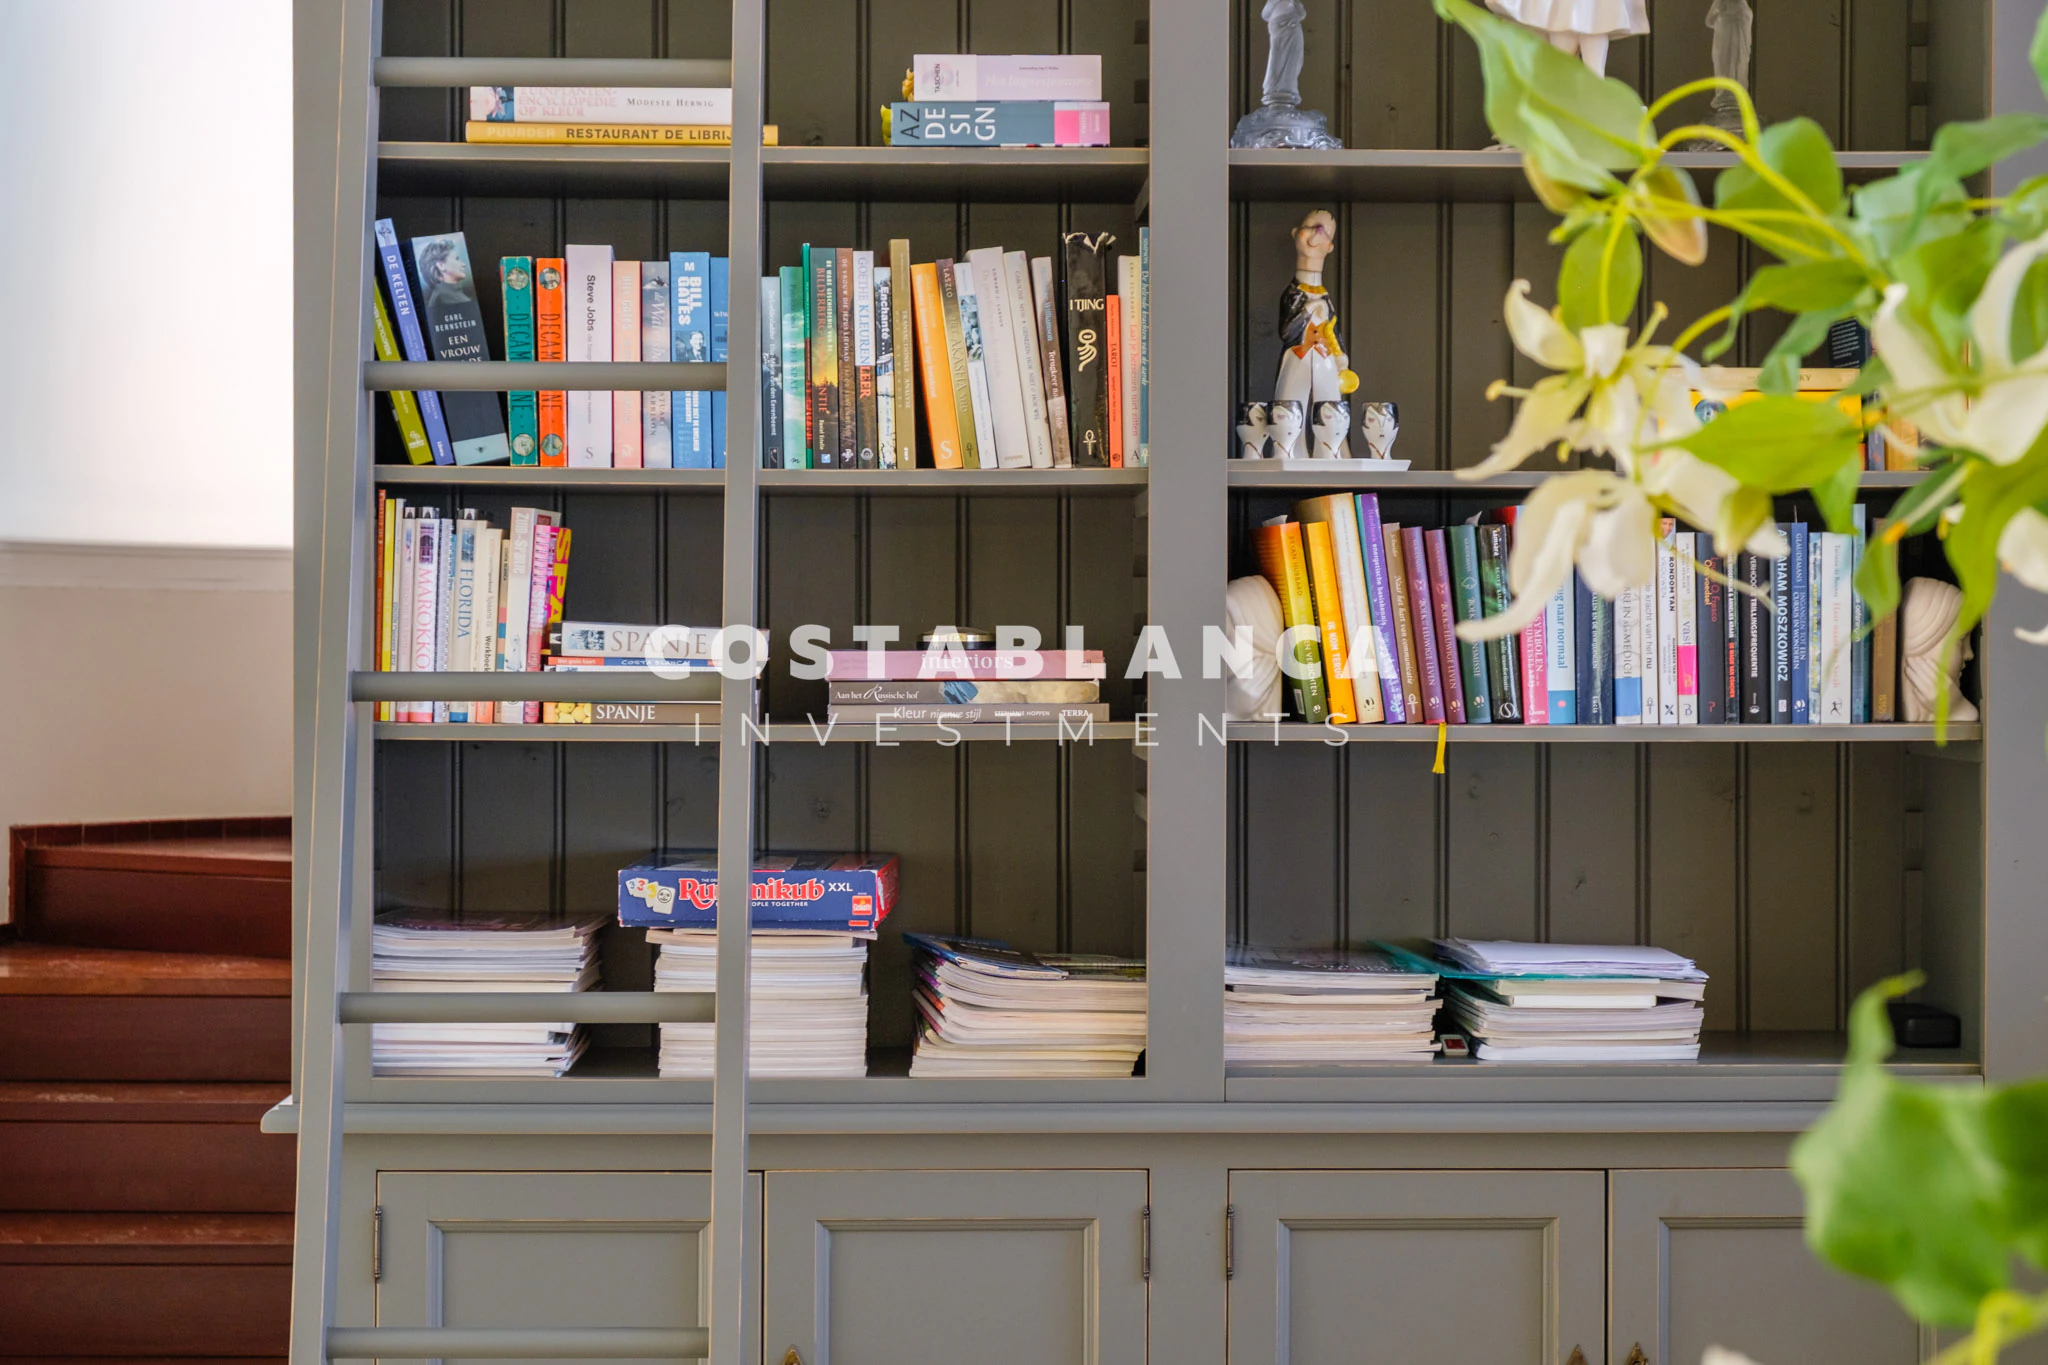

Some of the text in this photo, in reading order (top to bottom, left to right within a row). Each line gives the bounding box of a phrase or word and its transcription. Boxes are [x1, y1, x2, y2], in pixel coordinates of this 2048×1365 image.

[518, 96, 618, 107] ENCYCLOPEDIE
[566, 128, 659, 139] RESTAURANT
[664, 129, 684, 140] DE
[900, 108, 920, 140] AZ
[925, 107, 946, 140] DE
[386, 254, 410, 316] DE KELTEN
[586, 274, 597, 304] Steve
[857, 257, 869, 300] GOETHE
[942, 267, 953, 298] LASZLO
[1141, 270, 1149, 282] De
[677, 276, 691, 326] GATES
[689, 276, 703, 310] BILL
[1073, 298, 1104, 311] TJING
[1141, 283, 1149, 309] helende
[435, 319, 477, 333] BERNSTEIN
[444, 313, 464, 323] CARL
[586, 305, 597, 332] Jobs
[880, 286, 890, 340] Enchanté
[1141, 310, 1149, 340] krachten
[448, 335, 469, 346] EEN
[1129, 324, 1137, 341] Laat
[440, 345, 481, 359] VROUW
[952, 339, 968, 392] AKASHA
[1110, 342, 1118, 369] TAROT
[1048, 350, 1059, 386] Terugkeer
[1130, 353, 1138, 392] hersenen
[1131, 412, 1139, 437] zitten
[1288, 535, 1303, 596] BRYAN HUBBARD
[1371, 543, 1383, 585] energetische
[1377, 587, 1388, 626] basiskennis
[1394, 575, 1402, 593] Naar
[1668, 556, 1676, 612] RONDOM TAN
[456, 568, 473, 638] FLORIDA
[1397, 595, 1405, 605] het
[1399, 607, 1407, 622] hart
[1710, 595, 1720, 622] Fresco
[1792, 592, 1800, 618] CURSUS
[1832, 602, 1841, 622] Haar
[414, 568, 432, 670] MAROKKO
[1645, 594, 1654, 670] kracht van het nu
[611, 630, 707, 658] SPANJE
[1327, 621, 1343, 680] IK KOM TERUG
[1441, 601, 1451, 624] BOEK
[1448, 665, 1457, 689] LEVEN
[1534, 616, 1545, 672] SYMBOLEN
[1556, 604, 1568, 669] naar normaal
[1750, 598, 1758, 678] TRILLINGSFREQUENTIE
[1777, 595, 1788, 682] MOSZKOWICZ
[921, 653, 1014, 669] interiors
[1306, 652, 1319, 697] VERLICHTEN
[1401, 638, 1413, 685] communicatie
[1427, 662, 1437, 686] LEVEN
[834, 684, 920, 703] Aan het Russische hof
[596, 704, 656, 723] SPANJE
[893, 706, 927, 719] Kleur
[965, 708, 982, 721] stijl
[1061, 709, 1090, 717] TERRA
[828, 882, 853, 892] XXL
